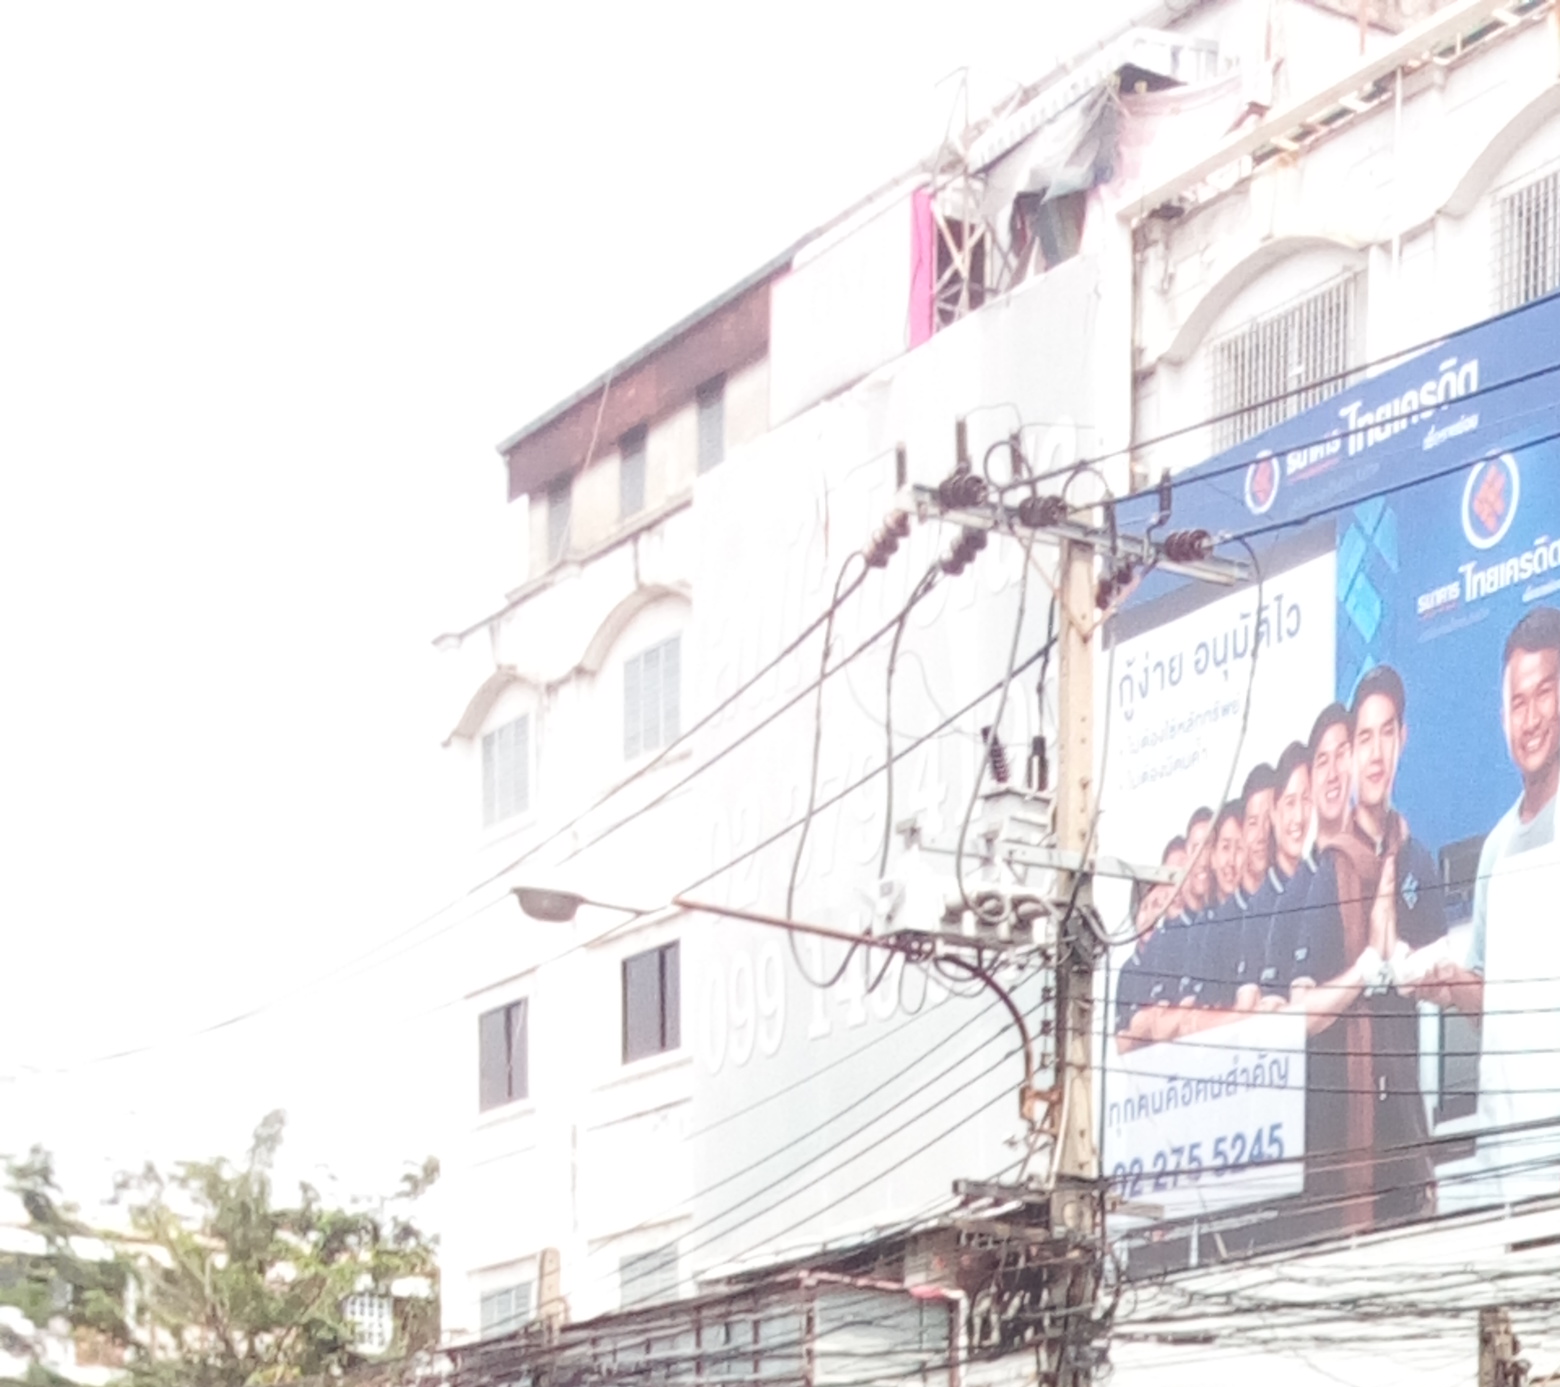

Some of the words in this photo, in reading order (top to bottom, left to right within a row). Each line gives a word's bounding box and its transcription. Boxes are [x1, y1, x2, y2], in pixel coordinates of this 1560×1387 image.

[1117, 648, 1185, 723] กู้ง่าย
[1193, 593, 1303, 684] อนุมัติไว
[1152, 1141, 1203, 1193] 275
[1212, 1121, 1285, 1178] 5245
